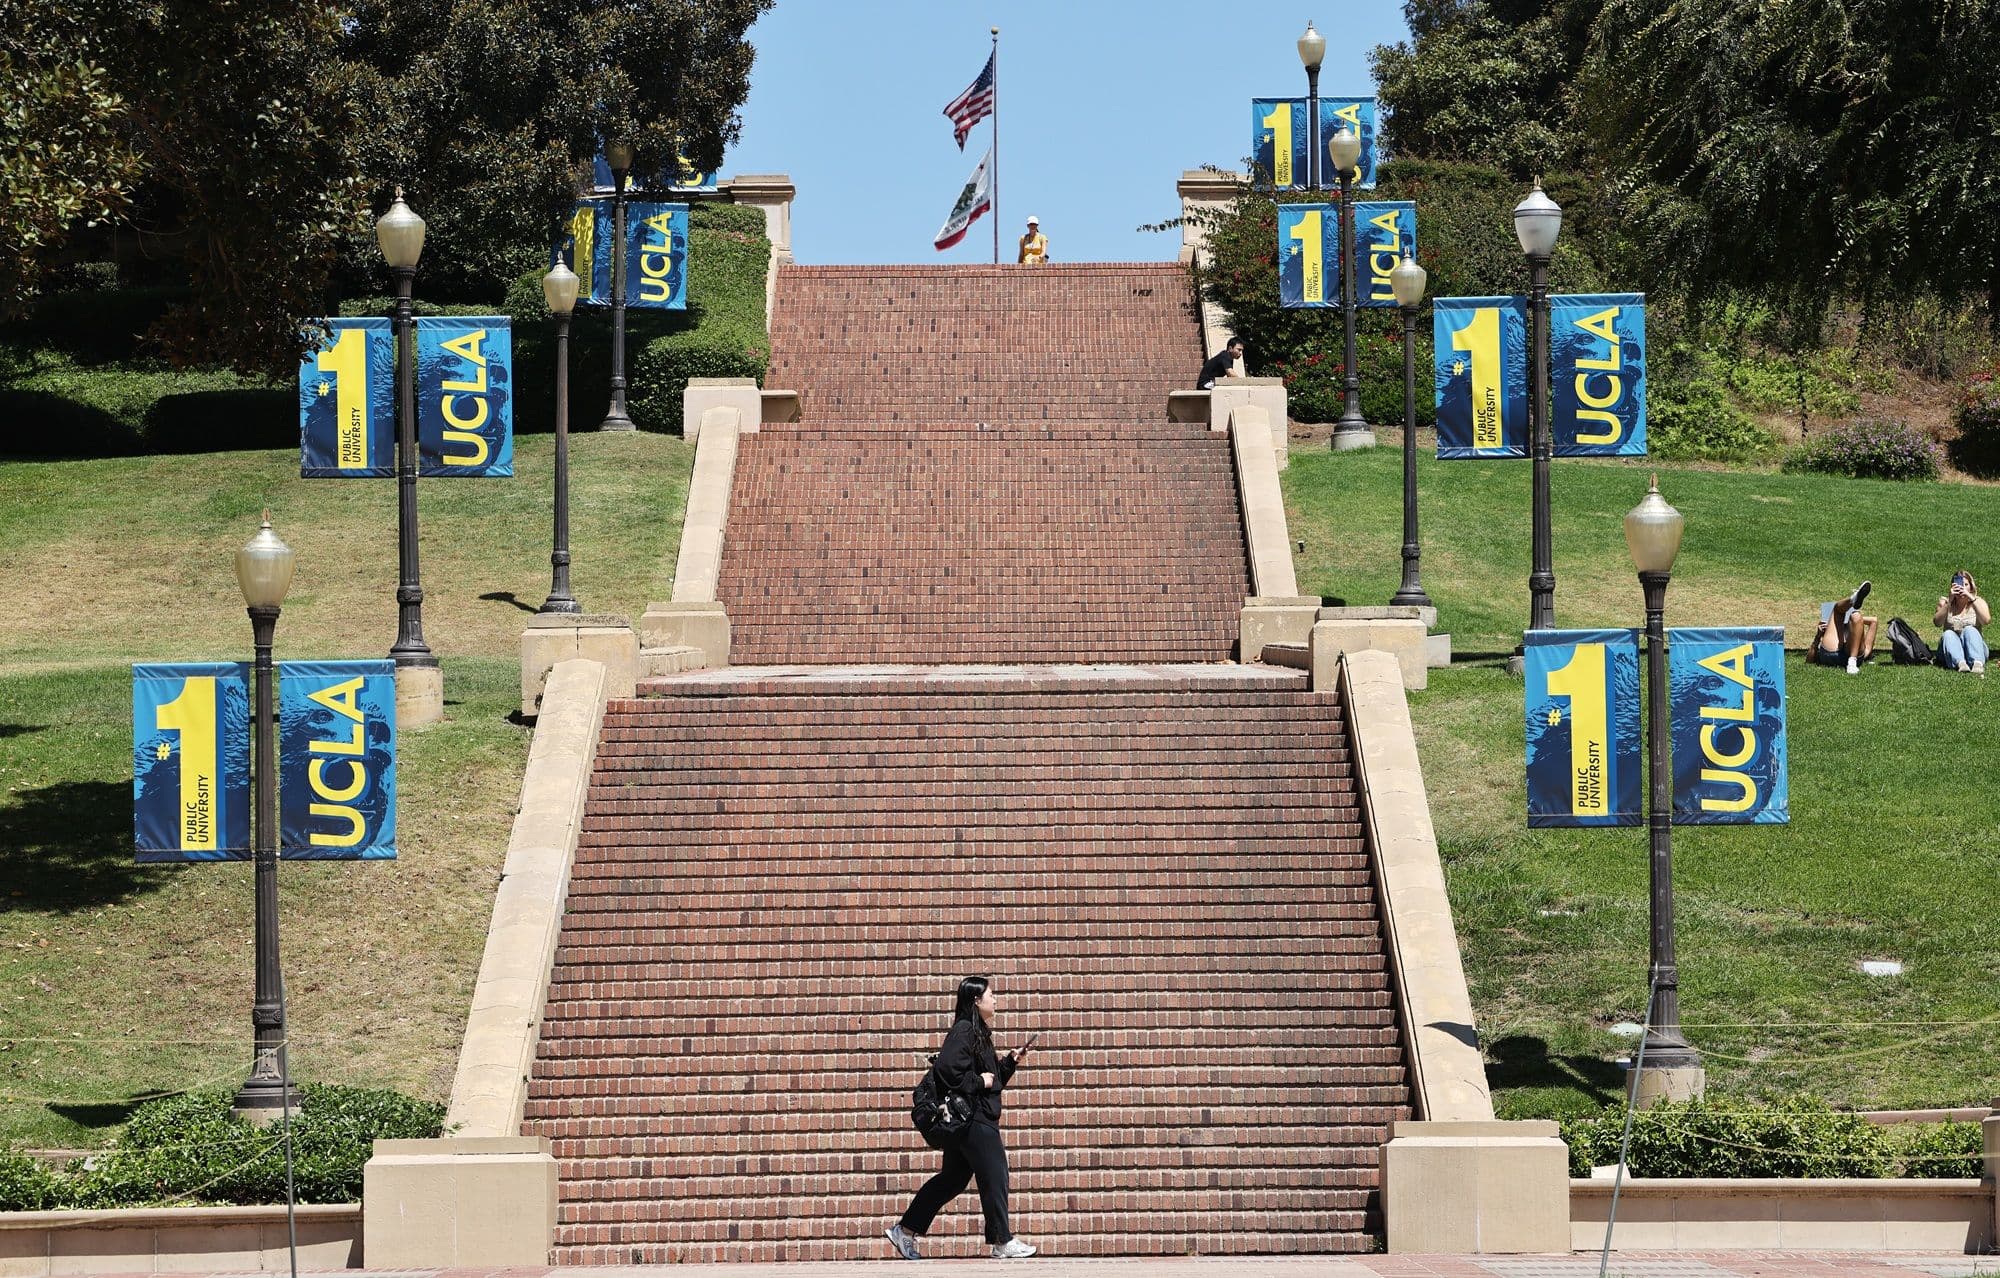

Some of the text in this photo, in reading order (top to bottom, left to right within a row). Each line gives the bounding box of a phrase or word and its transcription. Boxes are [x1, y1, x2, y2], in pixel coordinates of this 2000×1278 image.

[640, 211, 673, 302] UCLA
[440, 328, 489, 467] UCLA
[1573, 306, 1622, 445] UCLA
[343, 429, 352, 462] PUBLIC
[352, 407, 361, 463] UNIVERSITY
[1478, 408, 1487, 442] PUBLIC
[1487, 386, 1496, 442] UNIVERSITY
[307, 675, 366, 848] UCLA
[1697, 642, 1757, 812] UCLA
[198, 774, 209, 843] UNIVERSITY
[1578, 767, 1589, 808] PUBLIC
[1589, 740, 1601, 809] UNIVERSITY
[187, 801, 197, 842] PUBLIC
